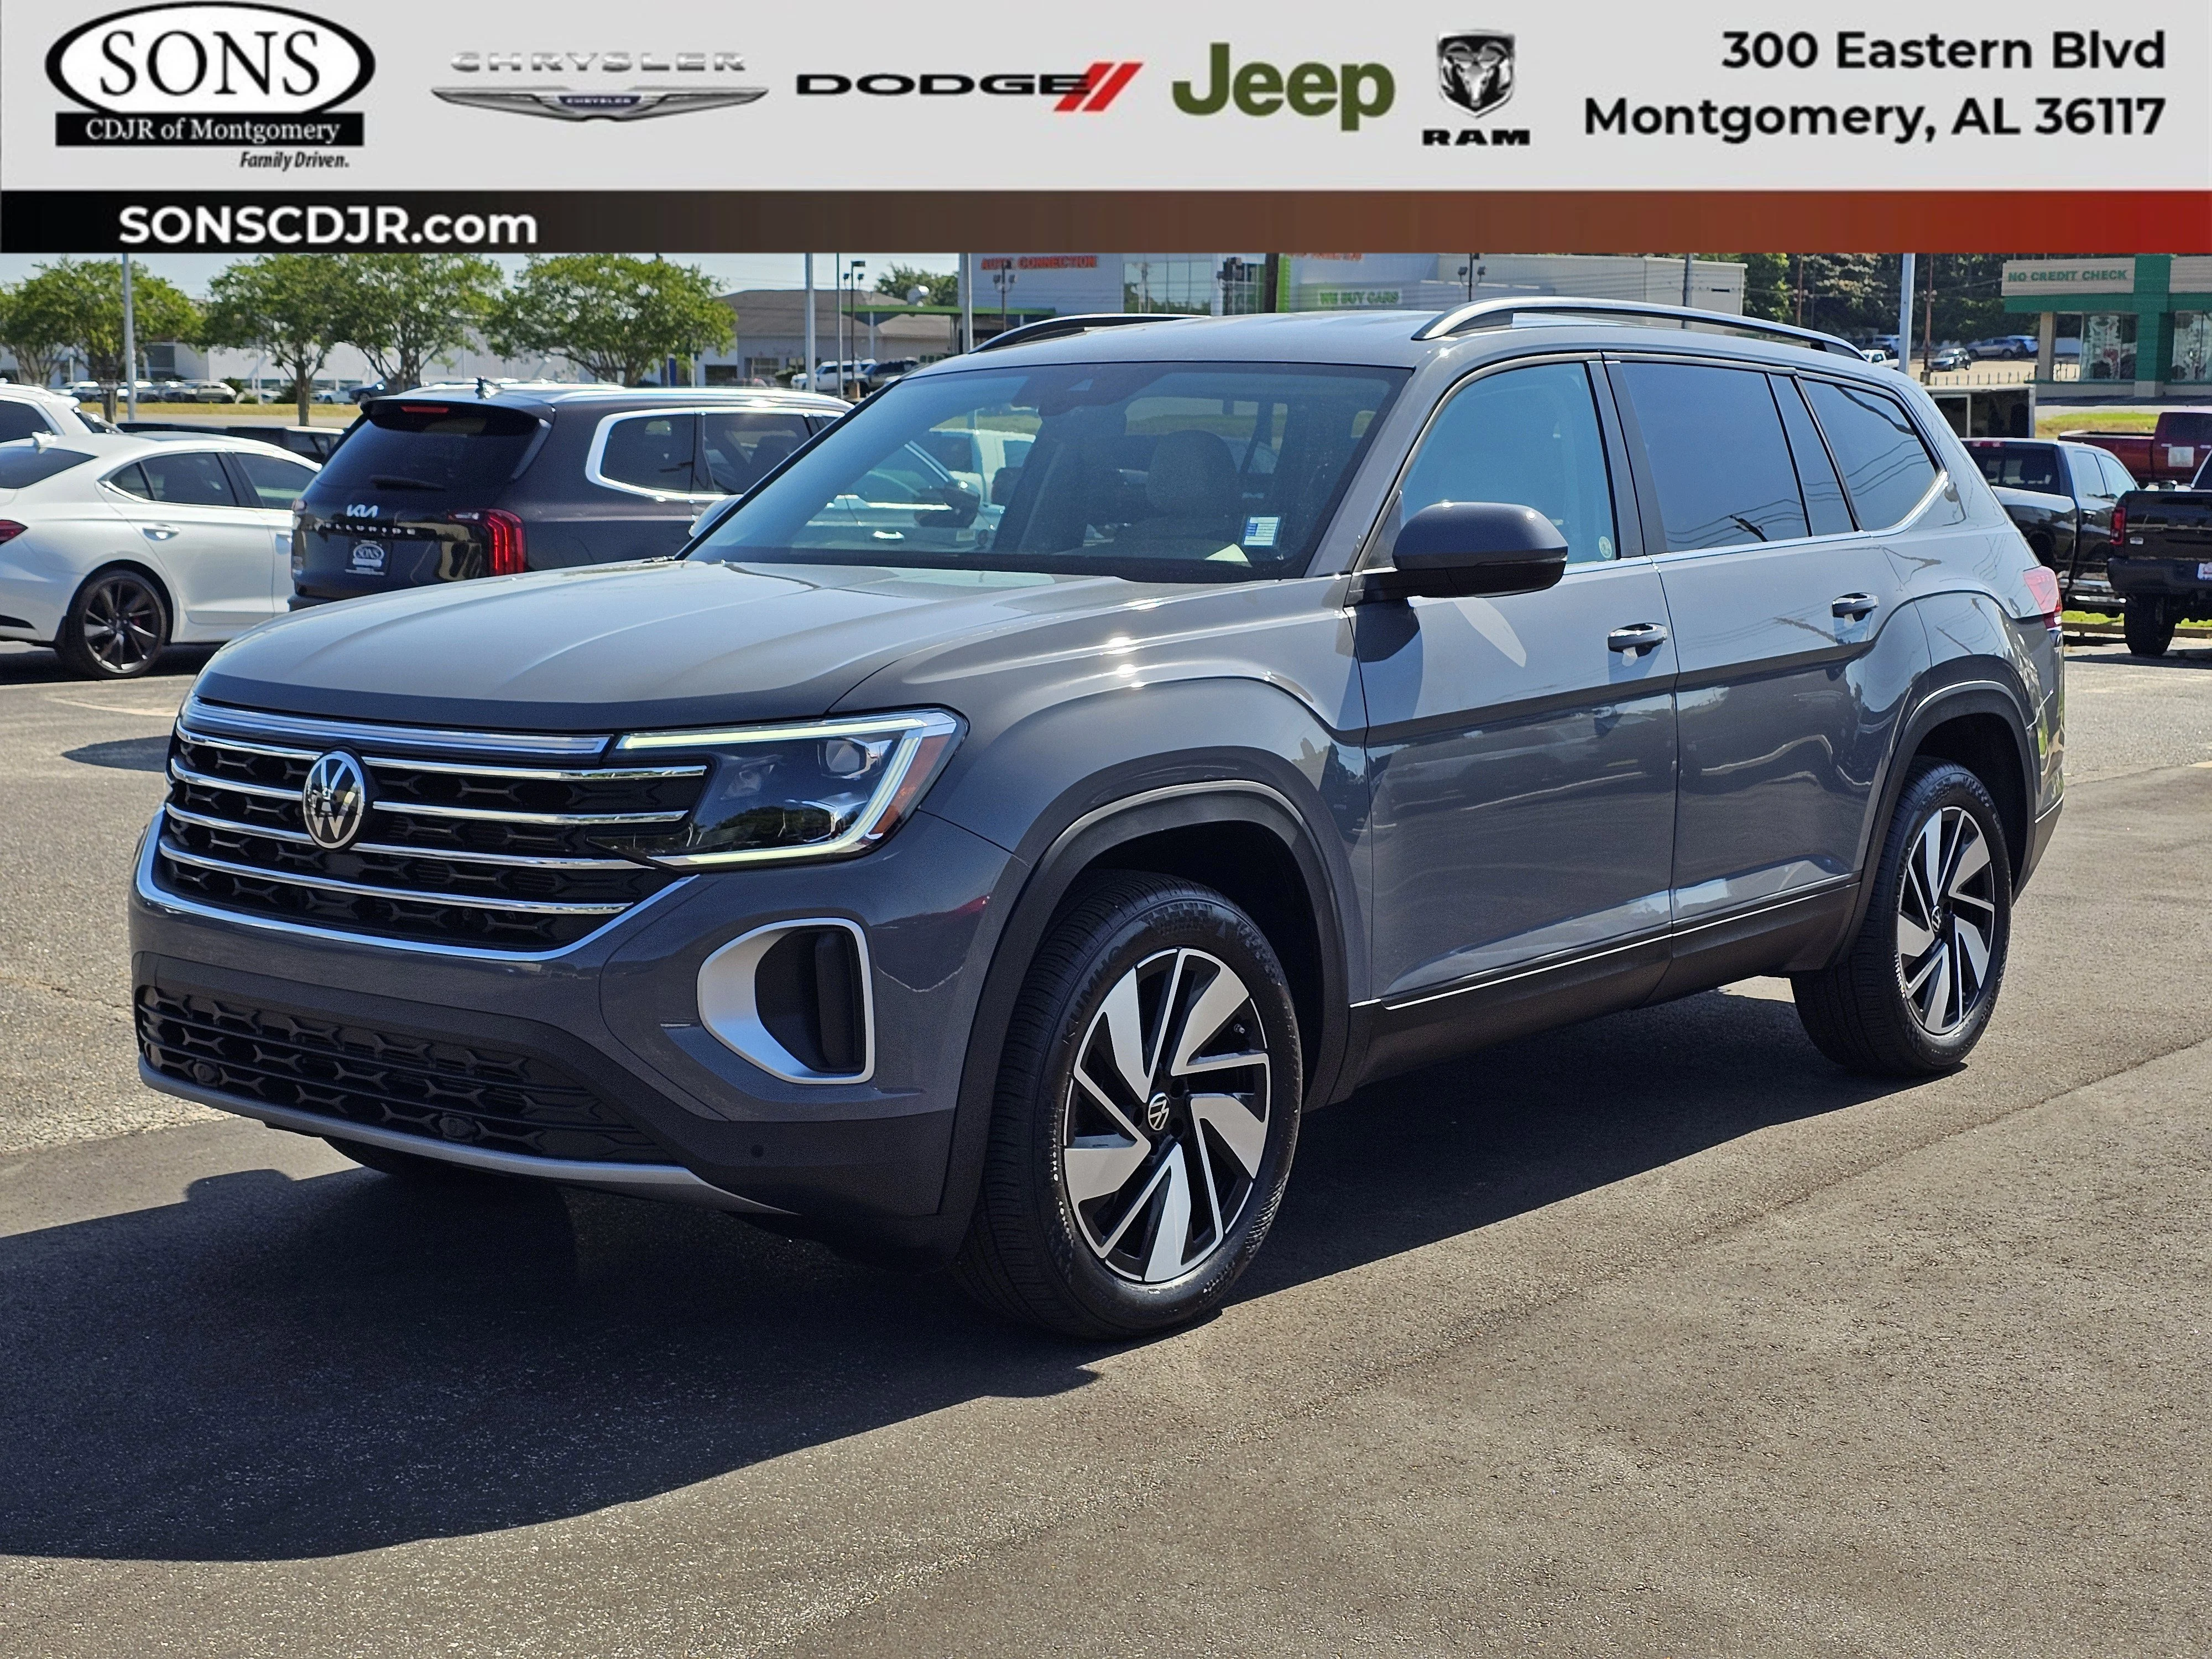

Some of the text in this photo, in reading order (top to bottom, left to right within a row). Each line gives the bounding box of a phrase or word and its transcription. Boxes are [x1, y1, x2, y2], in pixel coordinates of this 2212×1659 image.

[1018, 255, 1097, 269] CONNECTION
[2008, 270, 2127, 281] NO CREDIT CHECK
[1340, 292, 1365, 304] BUY
[346, 504, 378, 518] KIA
